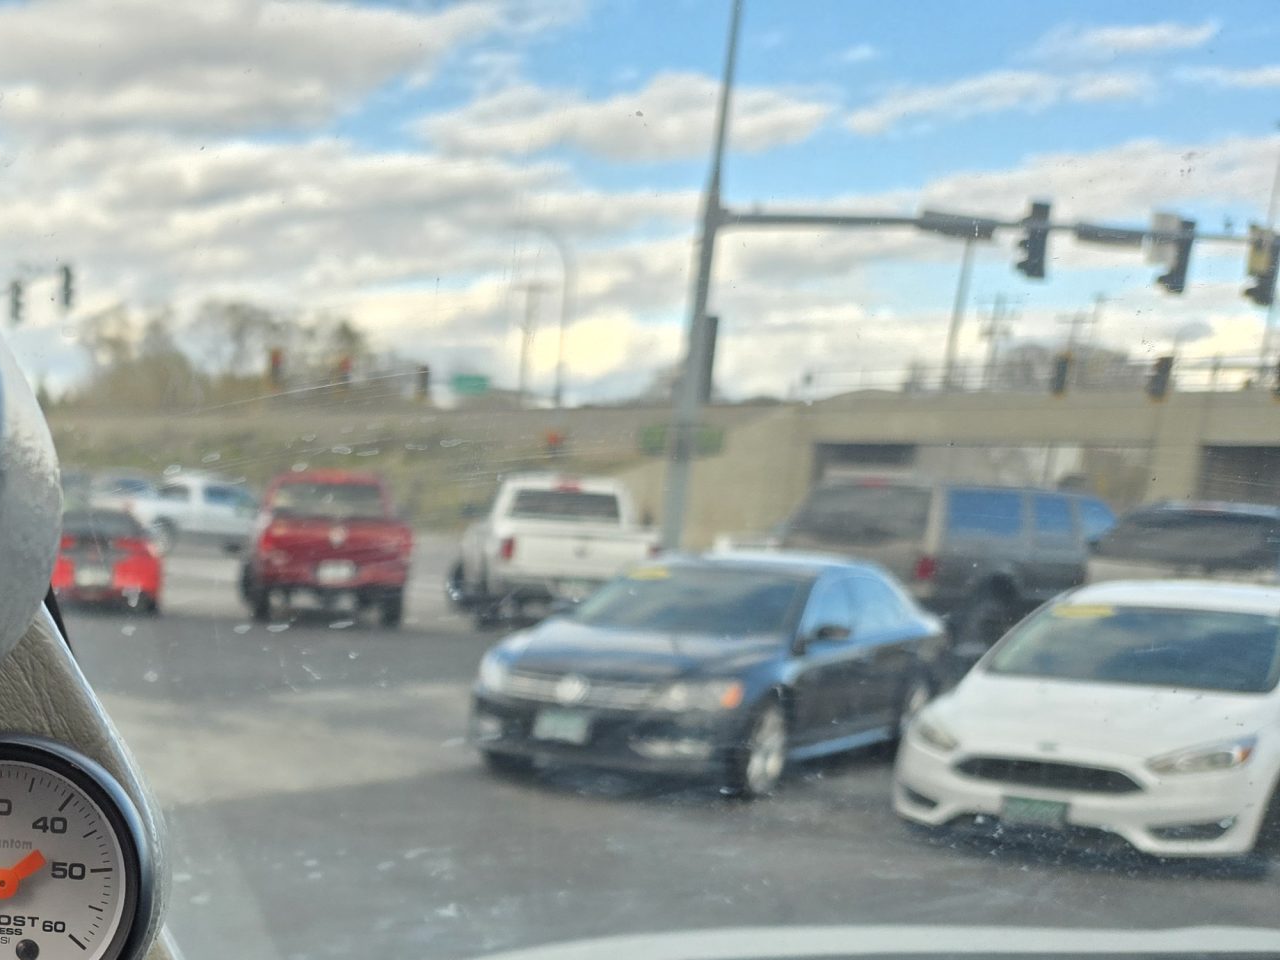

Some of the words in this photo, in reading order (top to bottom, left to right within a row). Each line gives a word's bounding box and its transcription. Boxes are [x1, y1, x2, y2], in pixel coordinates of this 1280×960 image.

[32, 816, 68, 834] 40
[51, 862, 86, 881] 50
[42, 920, 66, 933] 60
